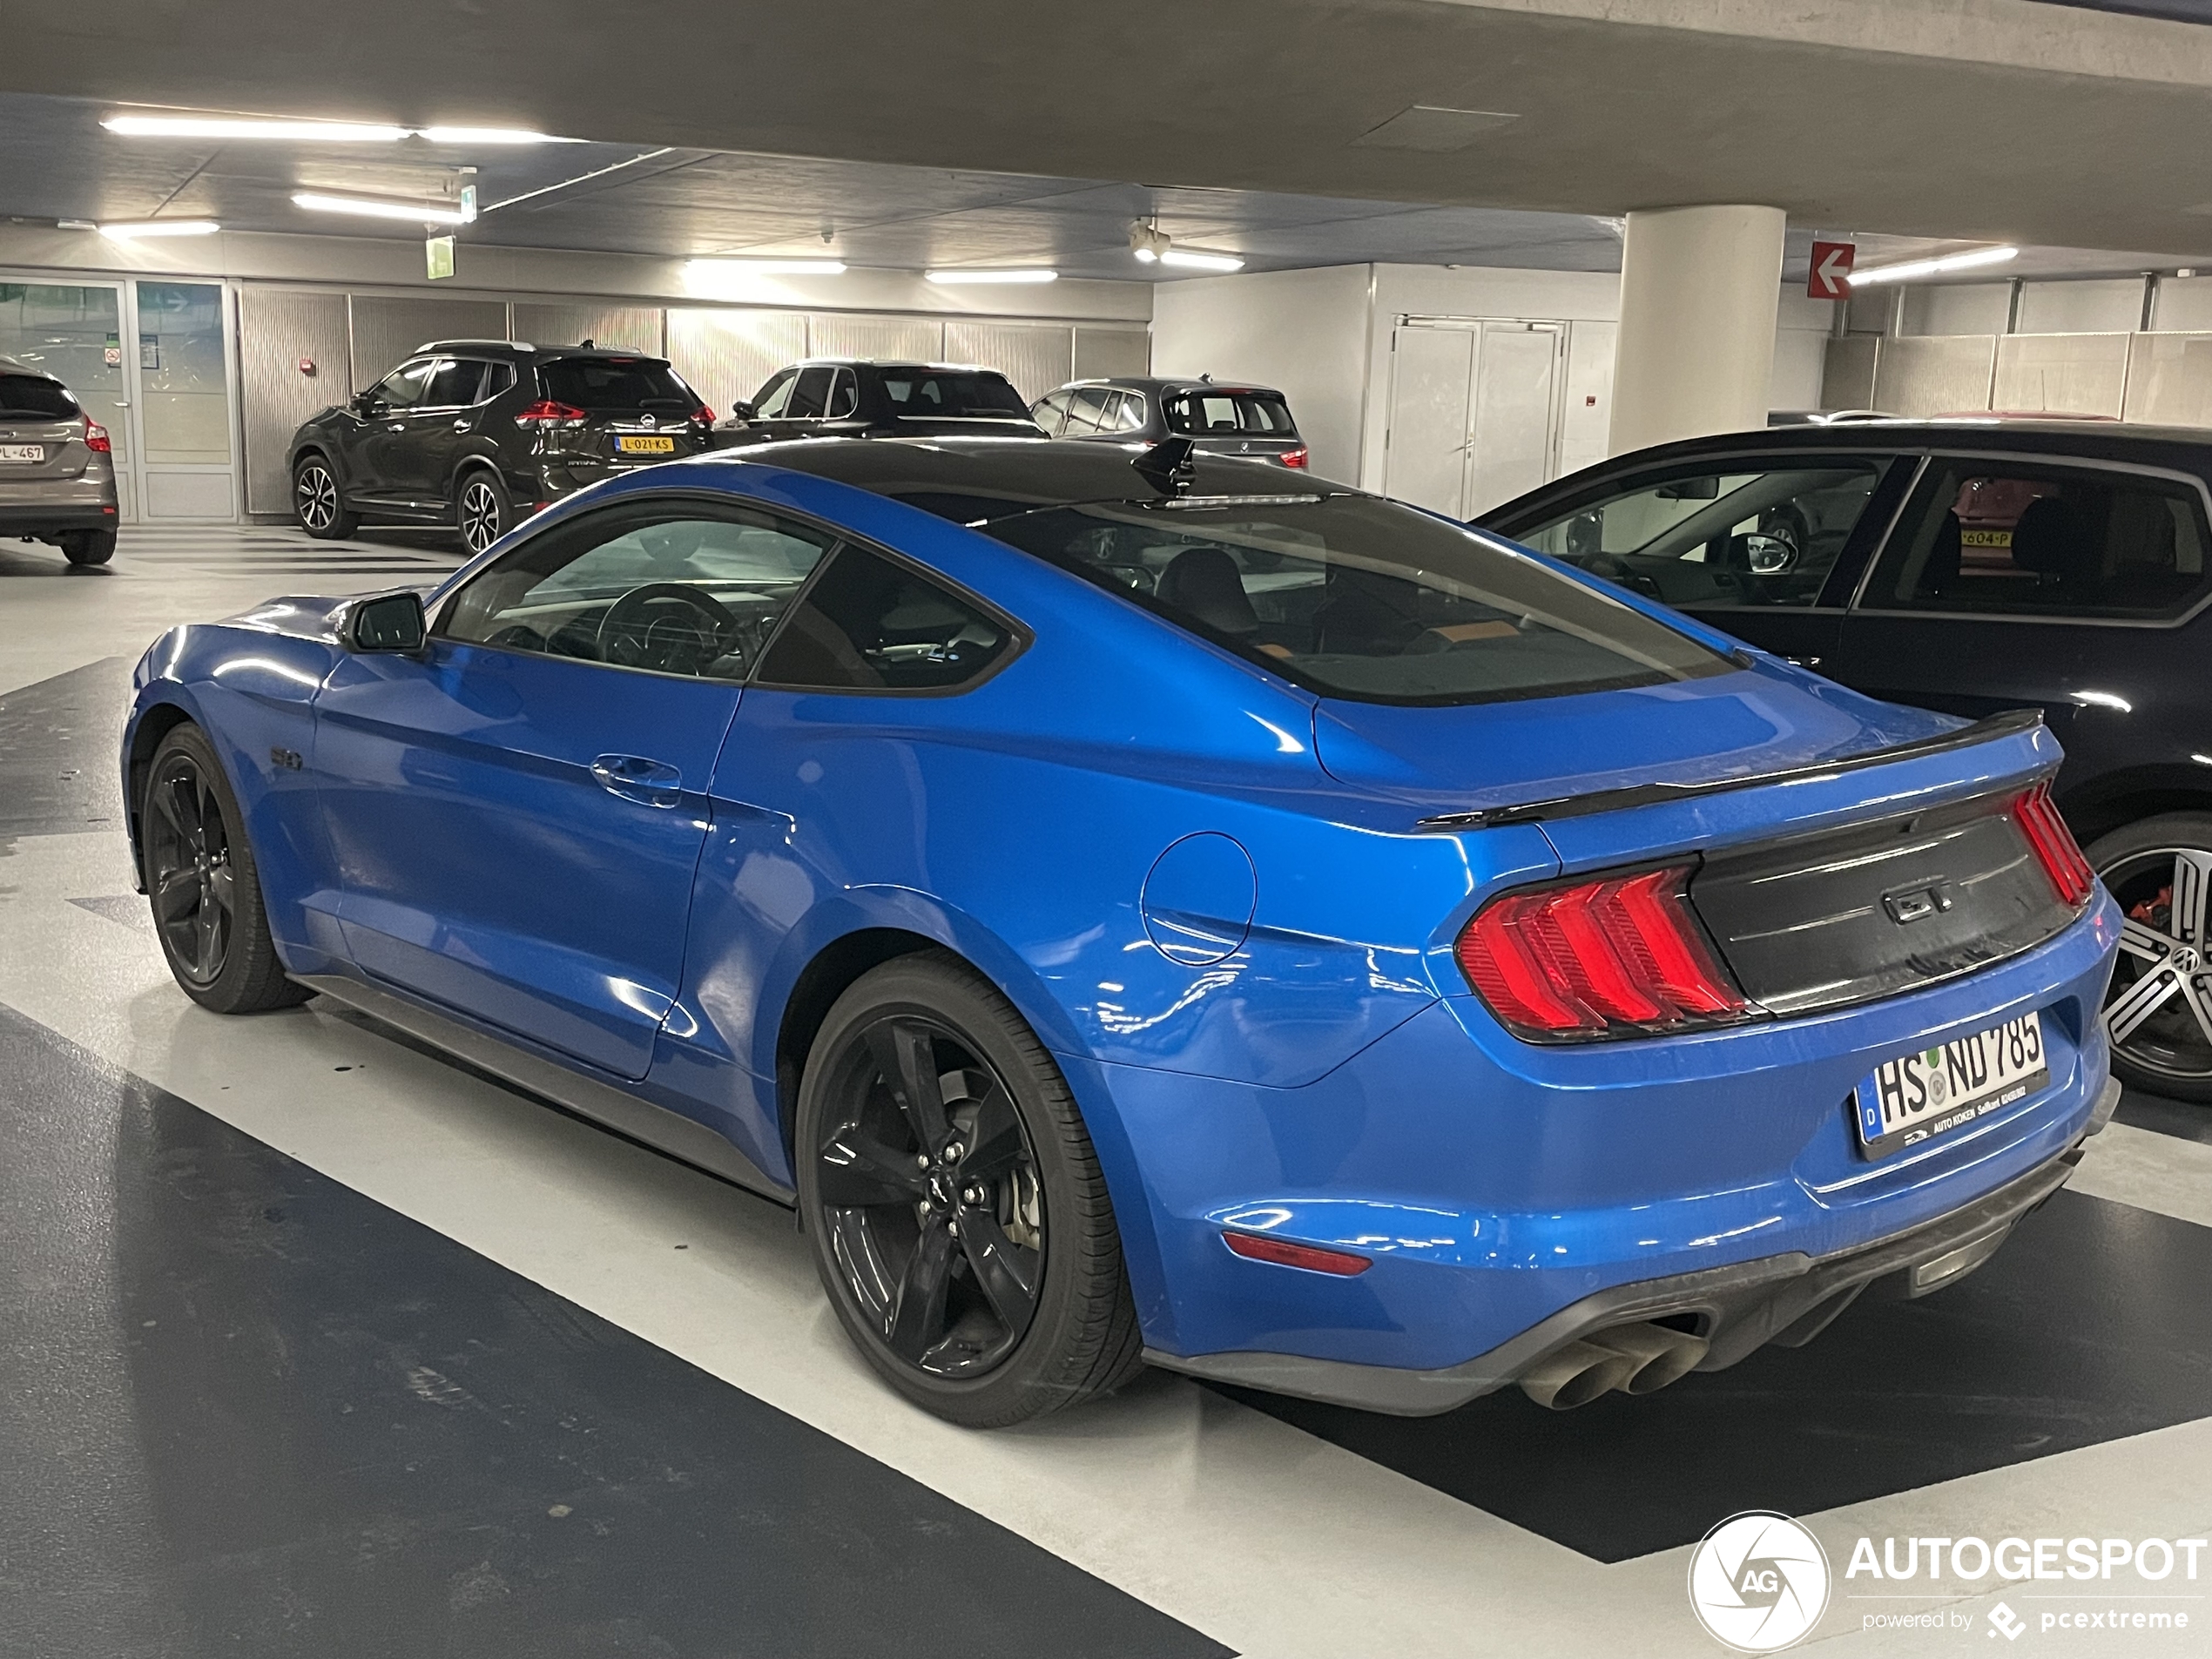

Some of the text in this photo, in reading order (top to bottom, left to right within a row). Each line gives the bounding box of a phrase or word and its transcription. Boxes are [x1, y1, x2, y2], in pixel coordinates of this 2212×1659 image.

[625, 439, 668, 449] L-021-KS
[1882, 874, 1952, 925] GT
[1878, 1054, 1927, 1123] HS
[1866, 1108, 1876, 1126] D
[1934, 1117, 1953, 1133] AUTO
